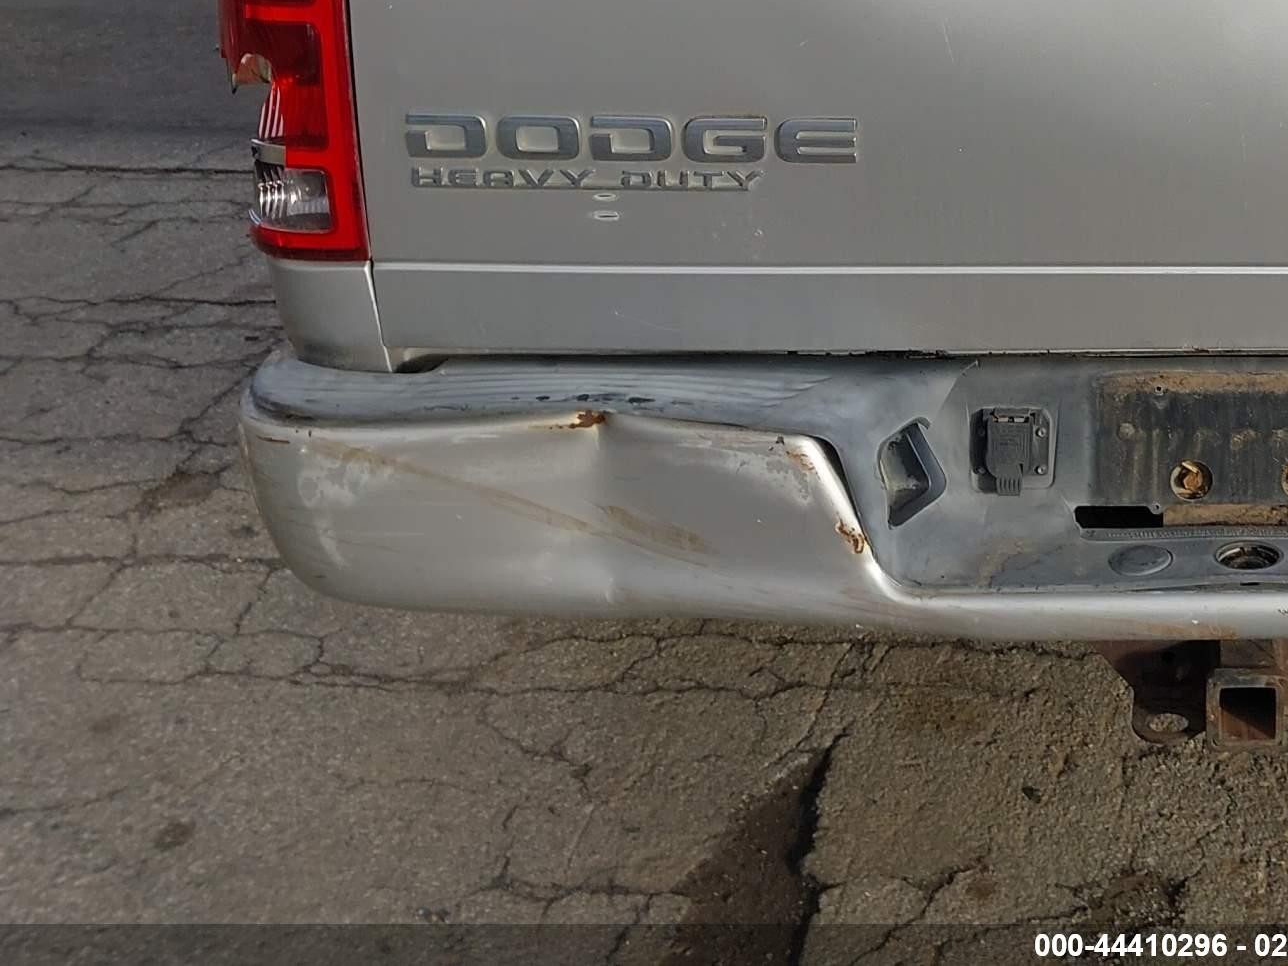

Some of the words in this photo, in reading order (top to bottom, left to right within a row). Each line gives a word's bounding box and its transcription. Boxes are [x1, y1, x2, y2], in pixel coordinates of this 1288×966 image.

[405, 114, 858, 163] DODGE
[411, 167, 596, 190] HEAVY
[620, 168, 766, 191] DUTY
